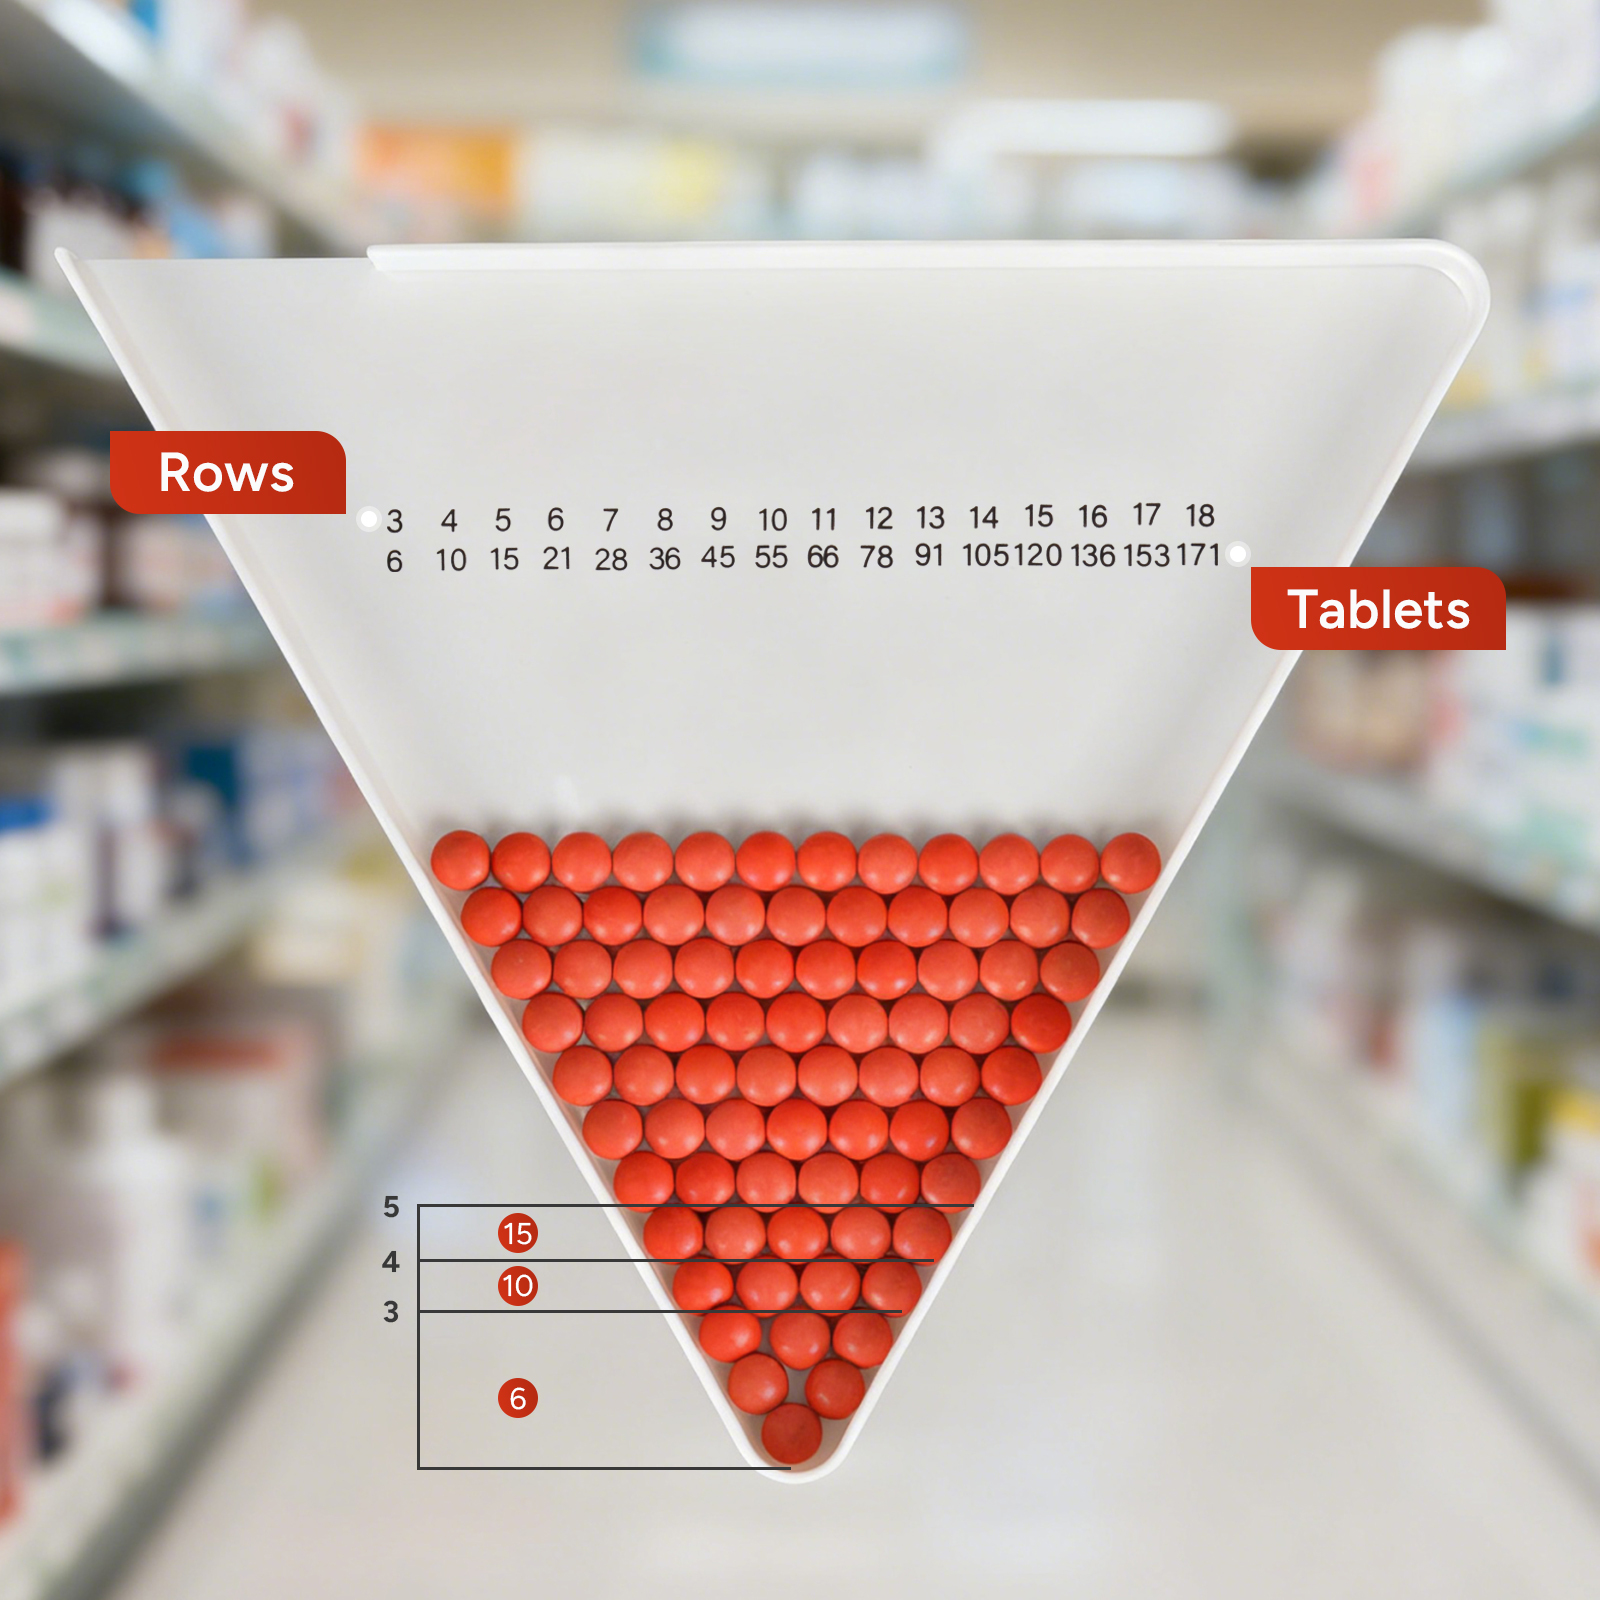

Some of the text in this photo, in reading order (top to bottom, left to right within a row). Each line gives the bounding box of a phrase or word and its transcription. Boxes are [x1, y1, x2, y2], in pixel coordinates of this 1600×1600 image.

[386, 502, 1215, 534] 3 4 5 6 7 8 9 10 11 12 13 14 15 16 17 18
[386, 542, 1219, 573] 6 10 15 21 28 36 45 55 66 78 91 105 120 136 153 171
